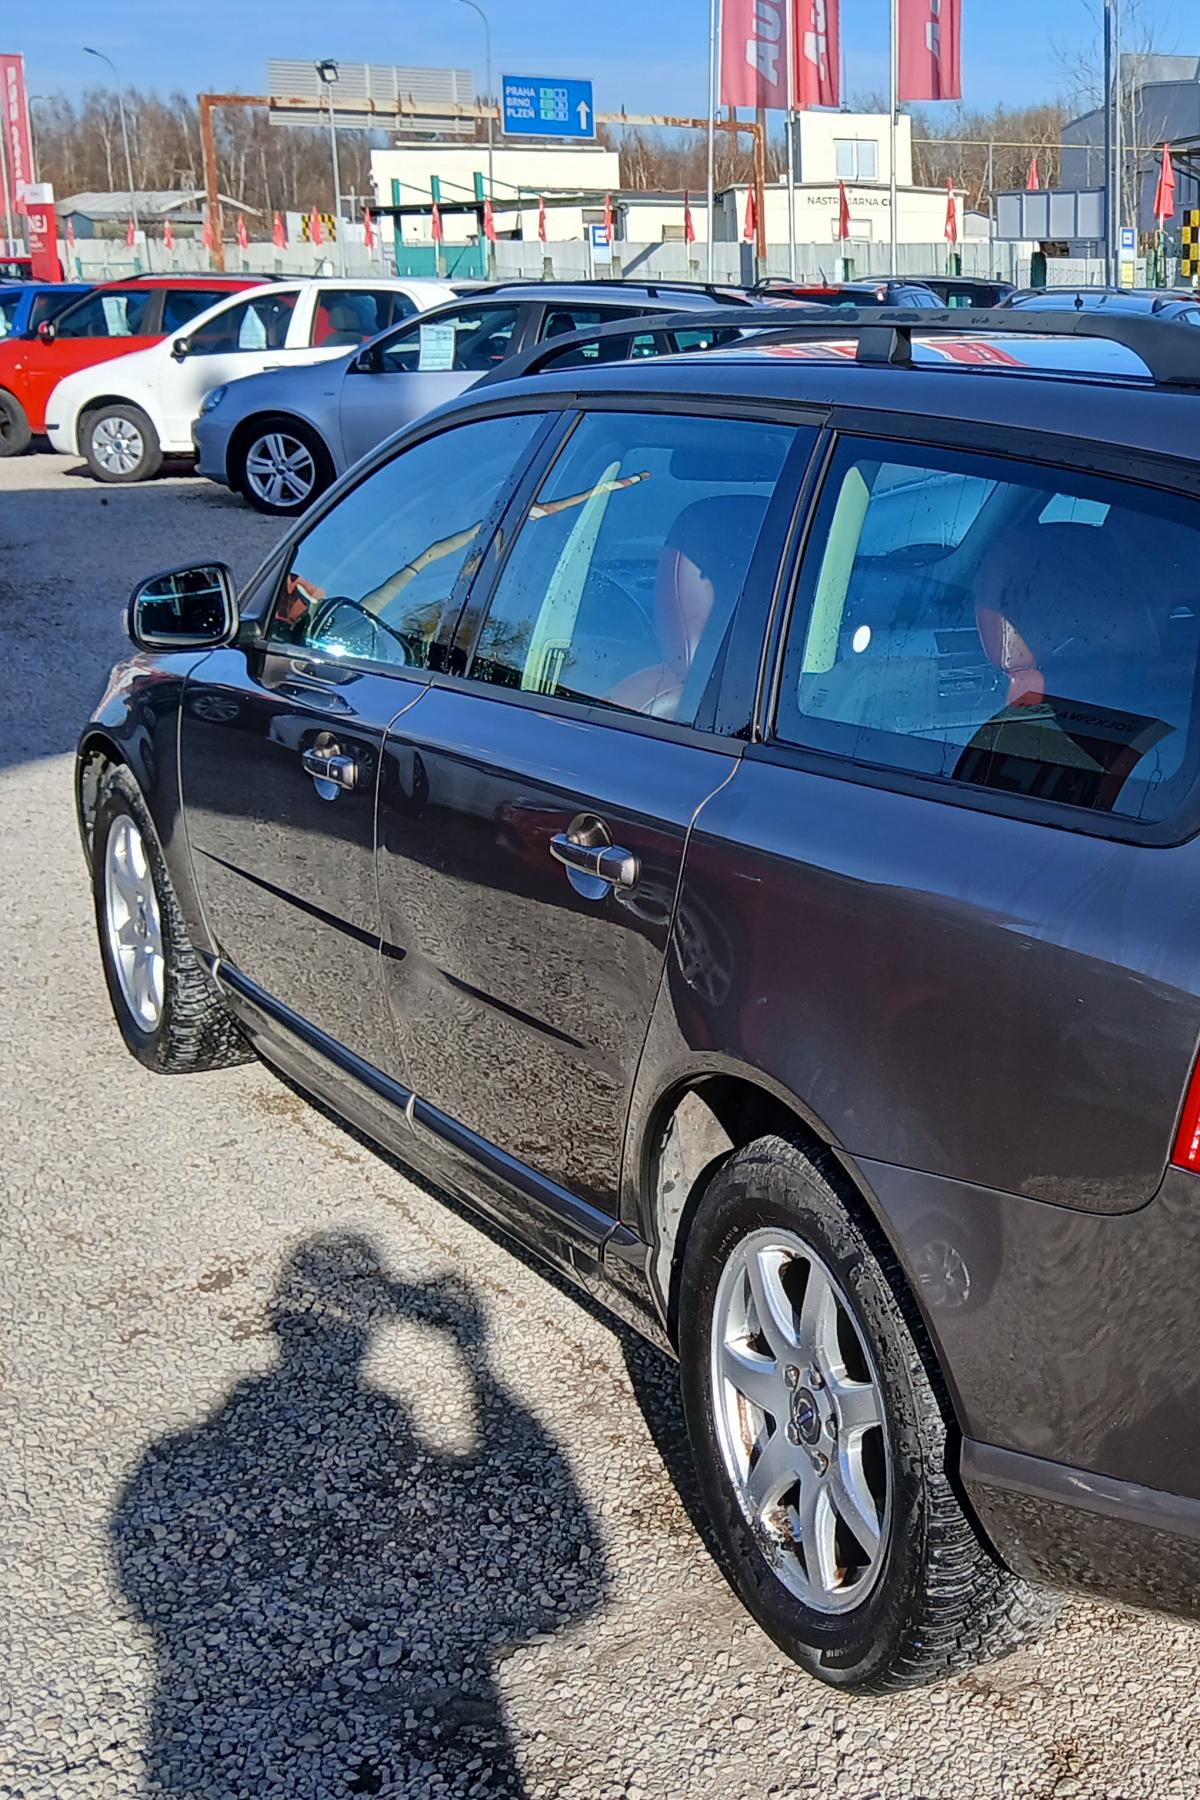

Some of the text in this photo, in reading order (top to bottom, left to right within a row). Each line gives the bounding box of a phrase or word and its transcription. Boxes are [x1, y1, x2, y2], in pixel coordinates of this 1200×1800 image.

[505, 86, 536, 97] PRAHA
[505, 97, 531, 107] BRNO
[506, 106, 535, 119] PLZEŇ
